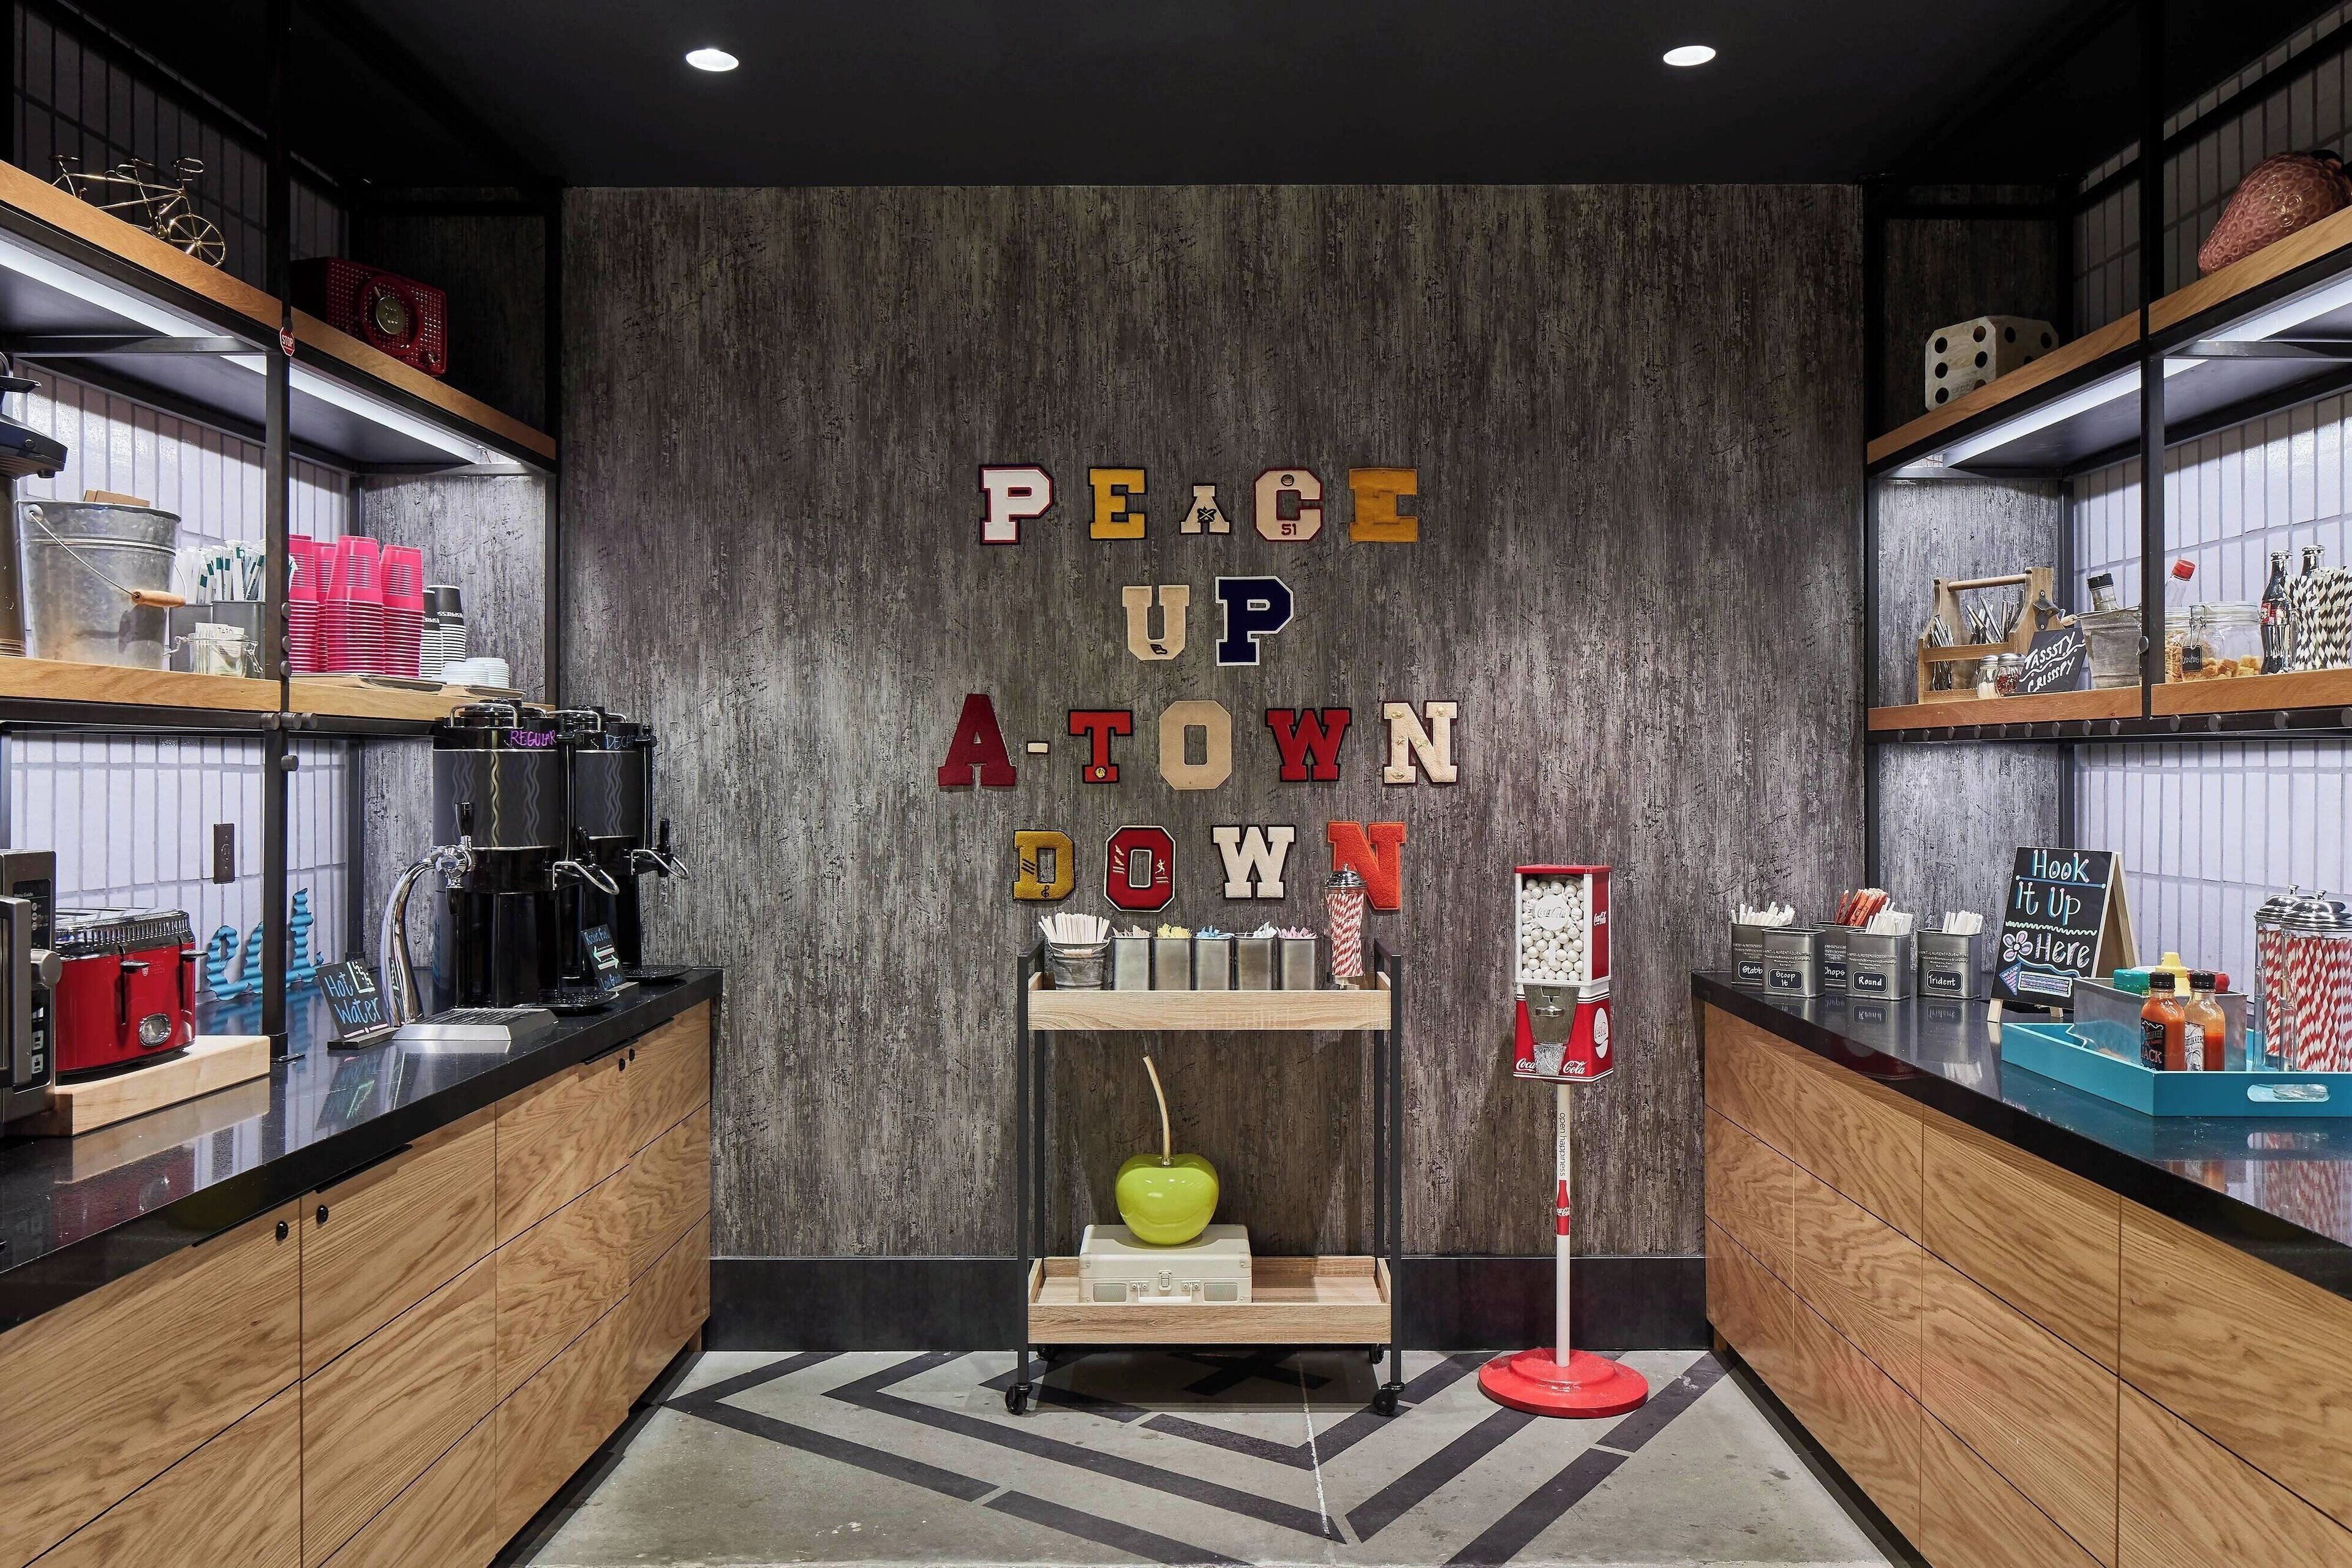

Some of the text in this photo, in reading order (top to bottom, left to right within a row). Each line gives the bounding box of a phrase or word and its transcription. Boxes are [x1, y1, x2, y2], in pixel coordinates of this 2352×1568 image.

[282, 334, 293, 348] STOP
[980, 464, 1419, 545] PEACE
[1281, 522, 1297, 536] 51
[1121, 575, 1294, 667] UP
[2024, 631, 2076, 670] TASSSTY
[2027, 656, 2075, 693] CRISSSPY
[509, 729, 557, 747] REGULAR
[938, 693, 1459, 791] A-TOWN
[1012, 821, 1407, 914] DOWN
[2032, 849, 2090, 883] Hook
[2016, 881, 2081, 926] It Up
[2034, 933, 2090, 968] Here
[324, 971, 353, 998] Hot
[1776, 971, 1796, 982] Scoop
[1858, 976, 1882, 986] Round
[1928, 974, 1956, 986] Trident
[334, 997, 381, 1024] Water
[1515, 1058, 1588, 1074] Coca Cola
[1558, 1135, 1567, 1177] happiness
